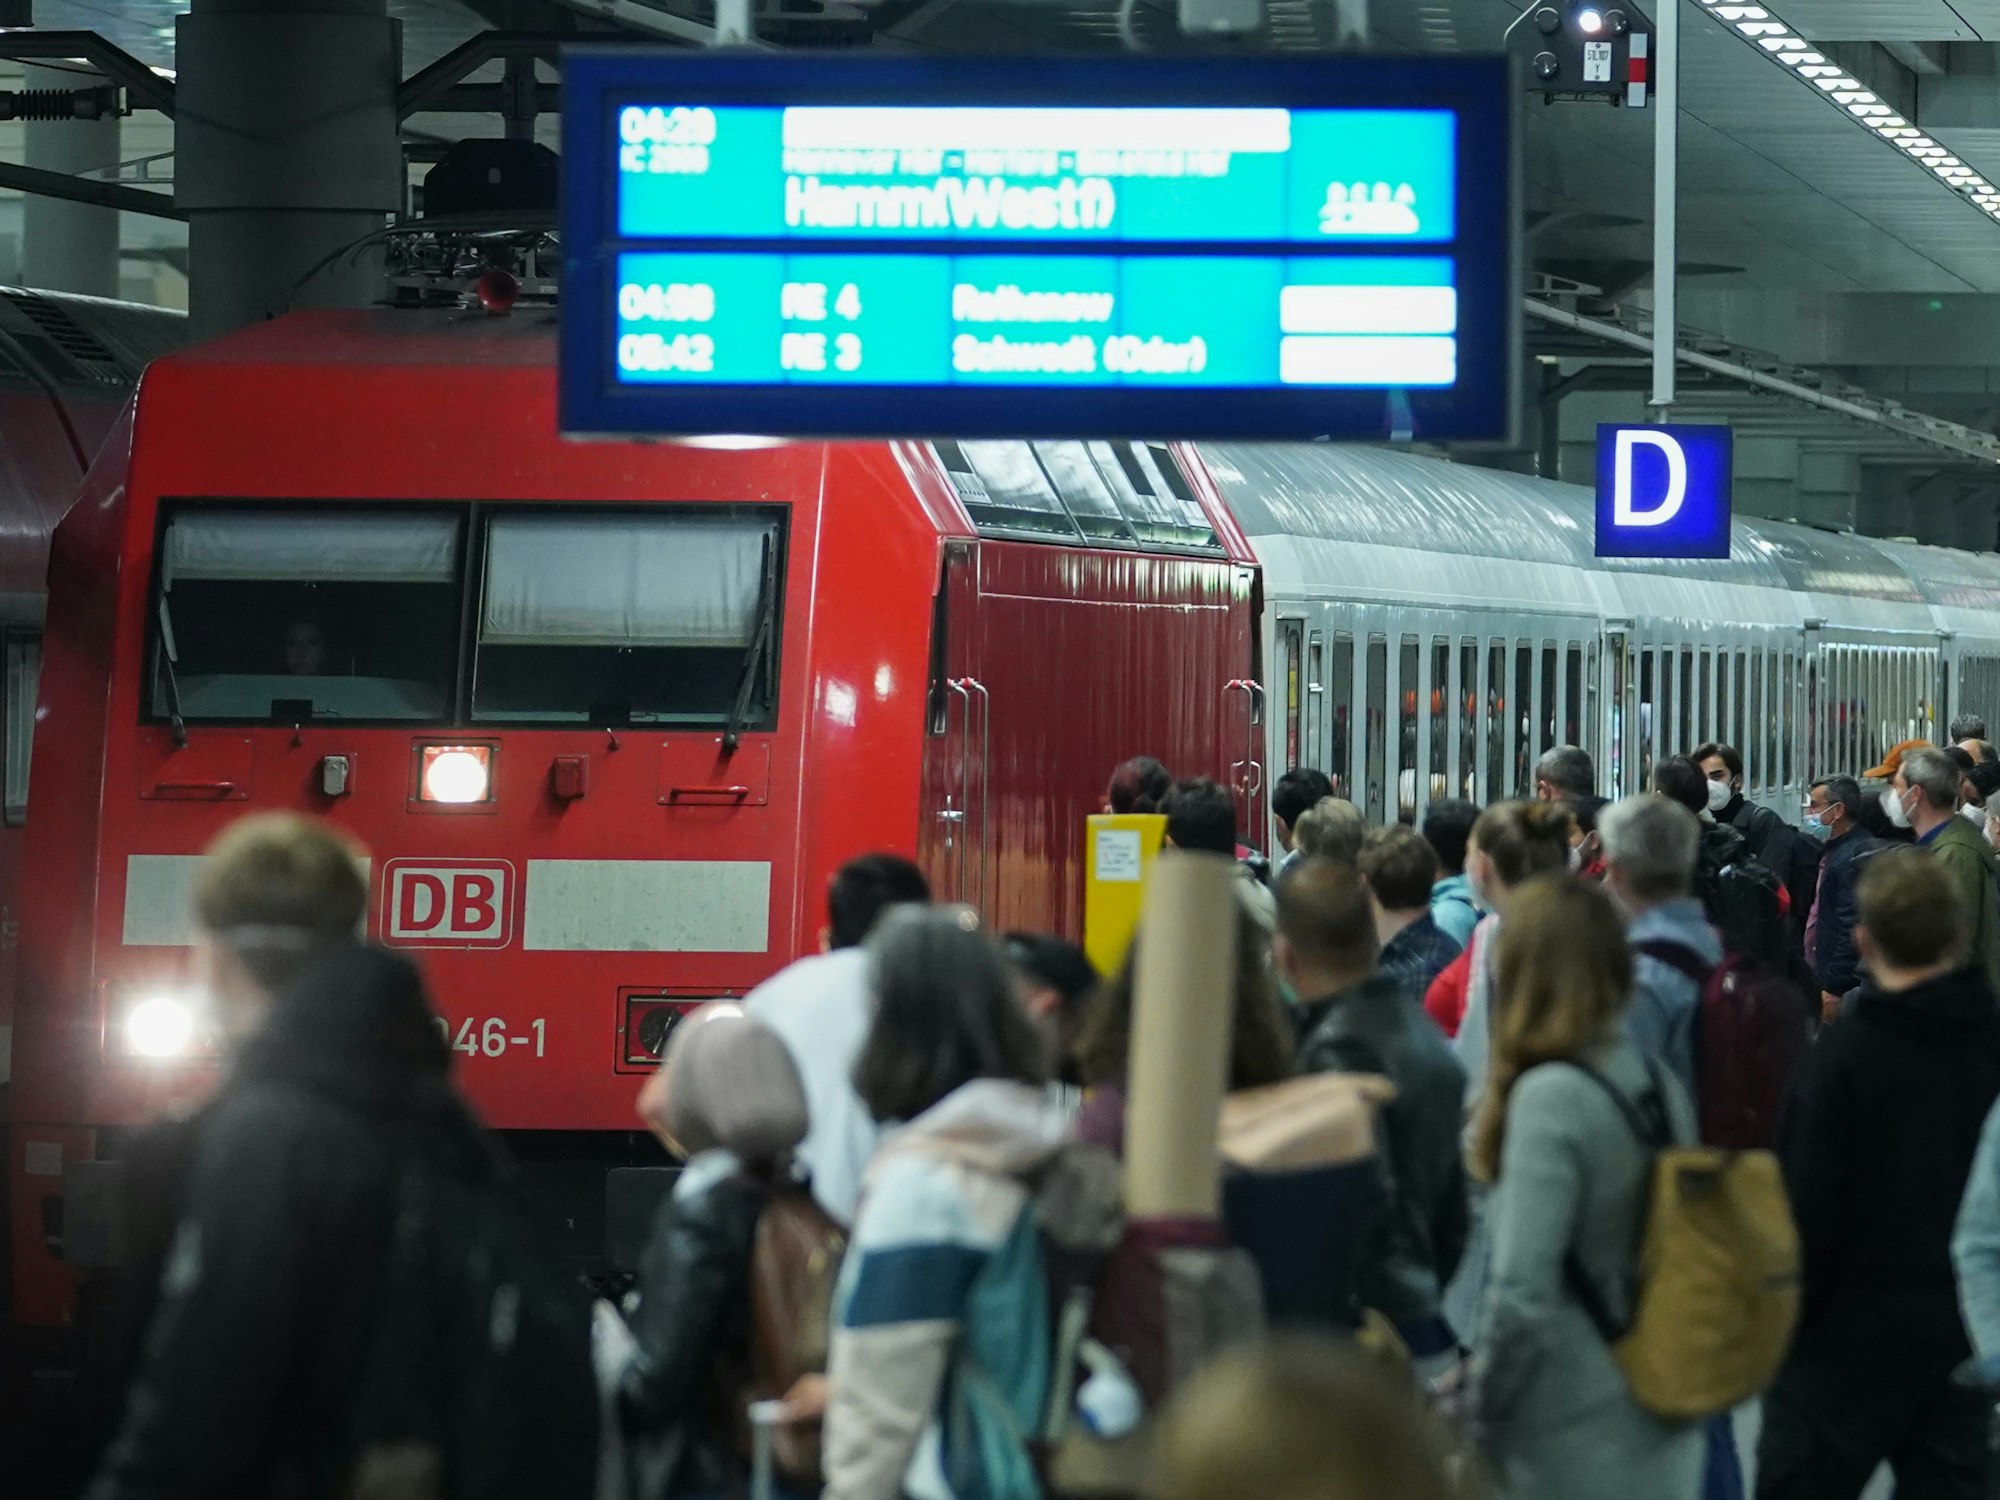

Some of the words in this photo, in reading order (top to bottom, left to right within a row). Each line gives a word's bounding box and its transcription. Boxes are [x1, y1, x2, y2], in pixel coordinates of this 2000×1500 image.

[1595, 64, 1601, 73] Y
[784, 175, 1116, 229] Hamm(Westf)
[781, 283, 827, 321] RE
[834, 283, 862, 321] 4
[781, 333, 827, 371] RE
[834, 333, 862, 371] 3
[1614, 429, 1687, 526] D
[399, 873, 496, 932] DB
